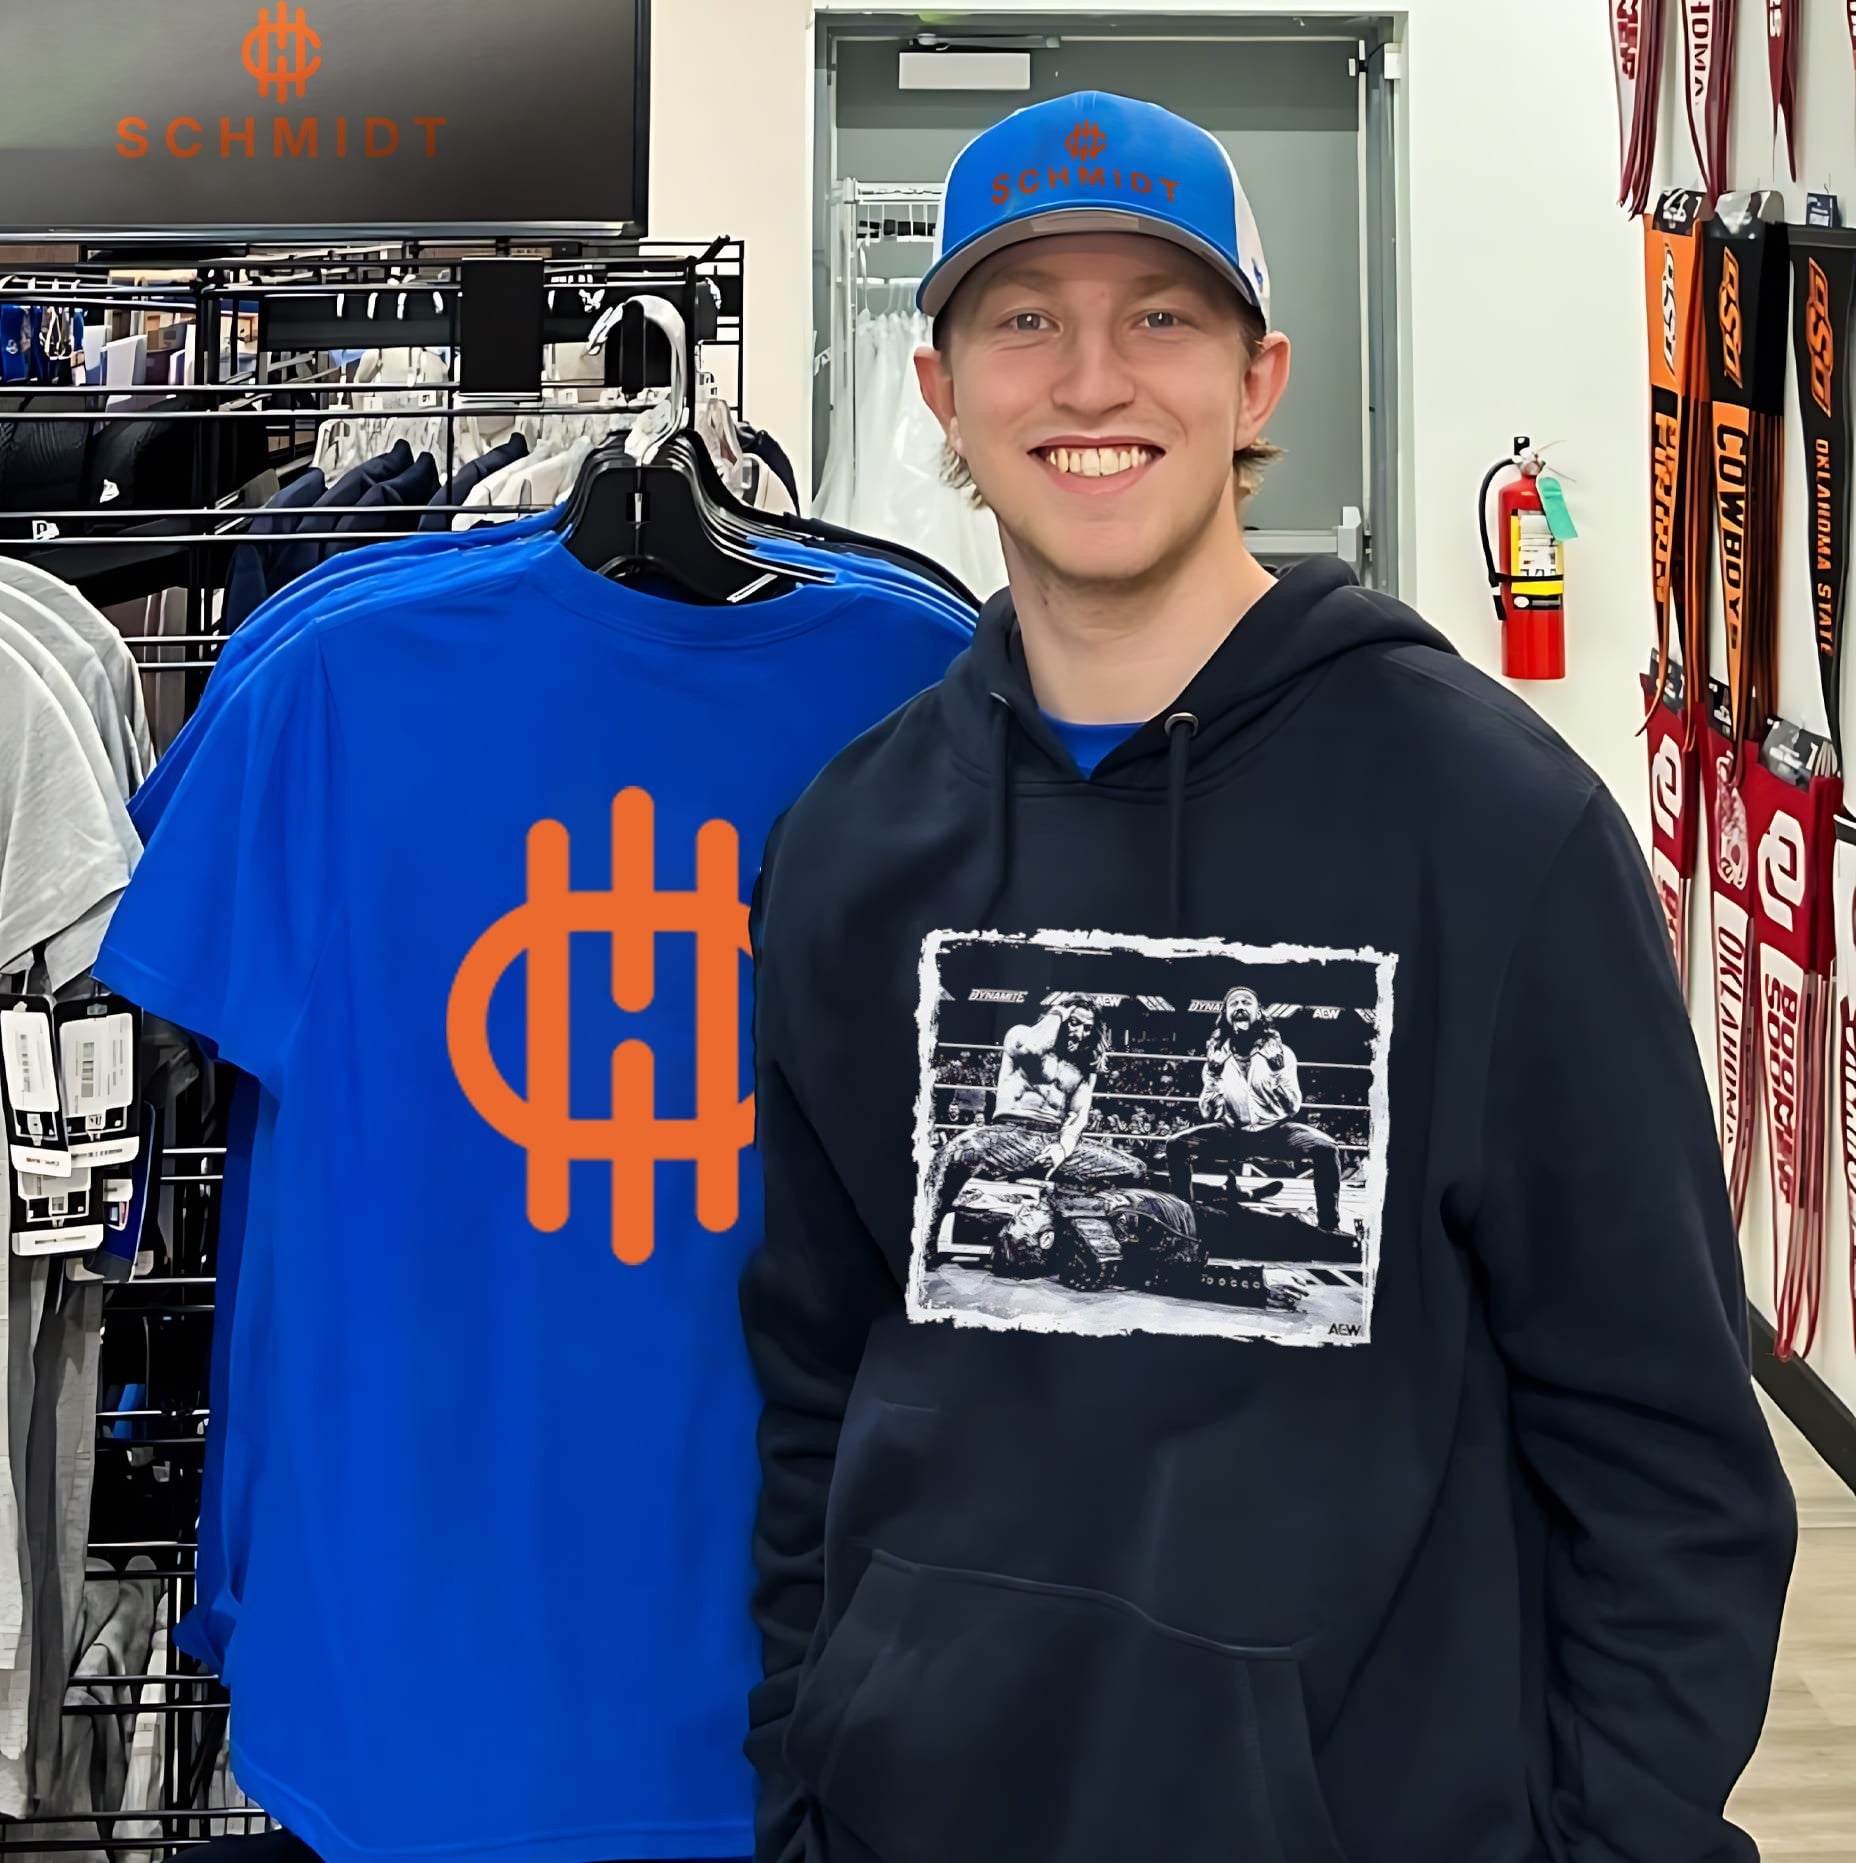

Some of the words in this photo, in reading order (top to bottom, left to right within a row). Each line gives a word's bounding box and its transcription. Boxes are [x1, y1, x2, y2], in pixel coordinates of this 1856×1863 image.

[116, 117, 447, 159] SCHMIDT
[992, 167, 1180, 204] SCHMIDT
[1815, 438, 1832, 570] OKLAHOMA
[968, 988, 1028, 1004] DYNAMITE
[1095, 994, 1122, 1008] AEW
[1188, 999, 1225, 1014] DYNA
[1312, 1008, 1340, 1020] AEW
[1328, 1322, 1361, 1337] AEW
